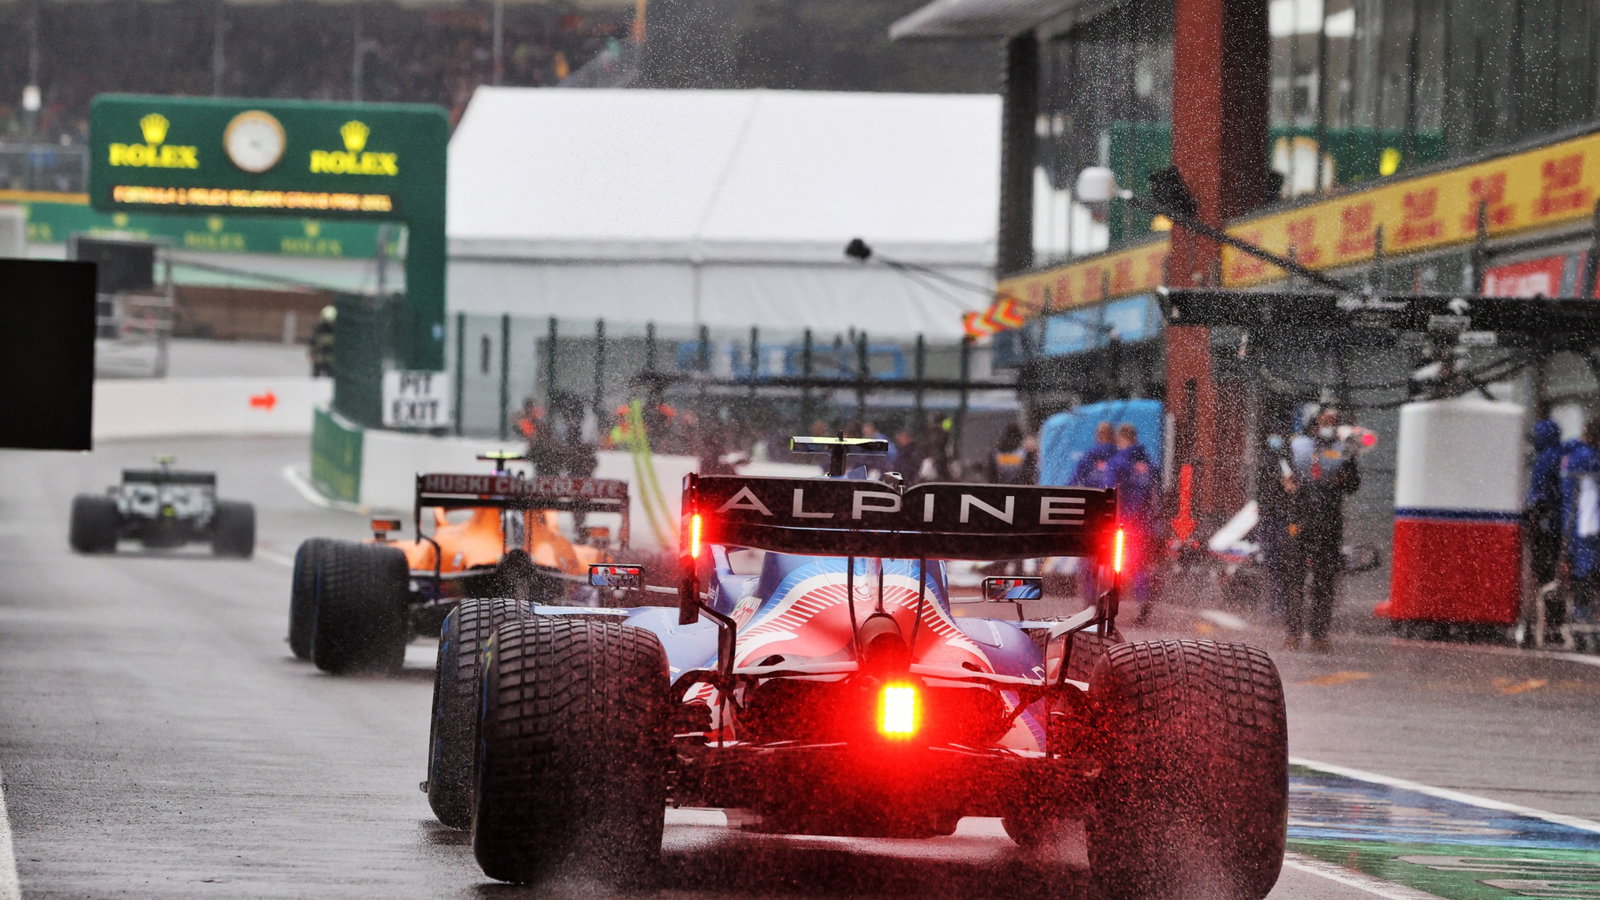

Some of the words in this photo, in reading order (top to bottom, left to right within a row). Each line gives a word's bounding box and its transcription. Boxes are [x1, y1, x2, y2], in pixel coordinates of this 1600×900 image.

[108, 143, 199, 169] ROLEX
[309, 150, 400, 176] ROLEX
[185, 233, 246, 250] ROLEX
[282, 237, 342, 255] ROLEX
[400, 373, 432, 394] PIT
[392, 400, 439, 422] EXIT
[423, 475, 489, 493] HUSKI
[495, 476, 621, 497] CHOCOLATE
[716, 485, 1086, 525] ALPINE
